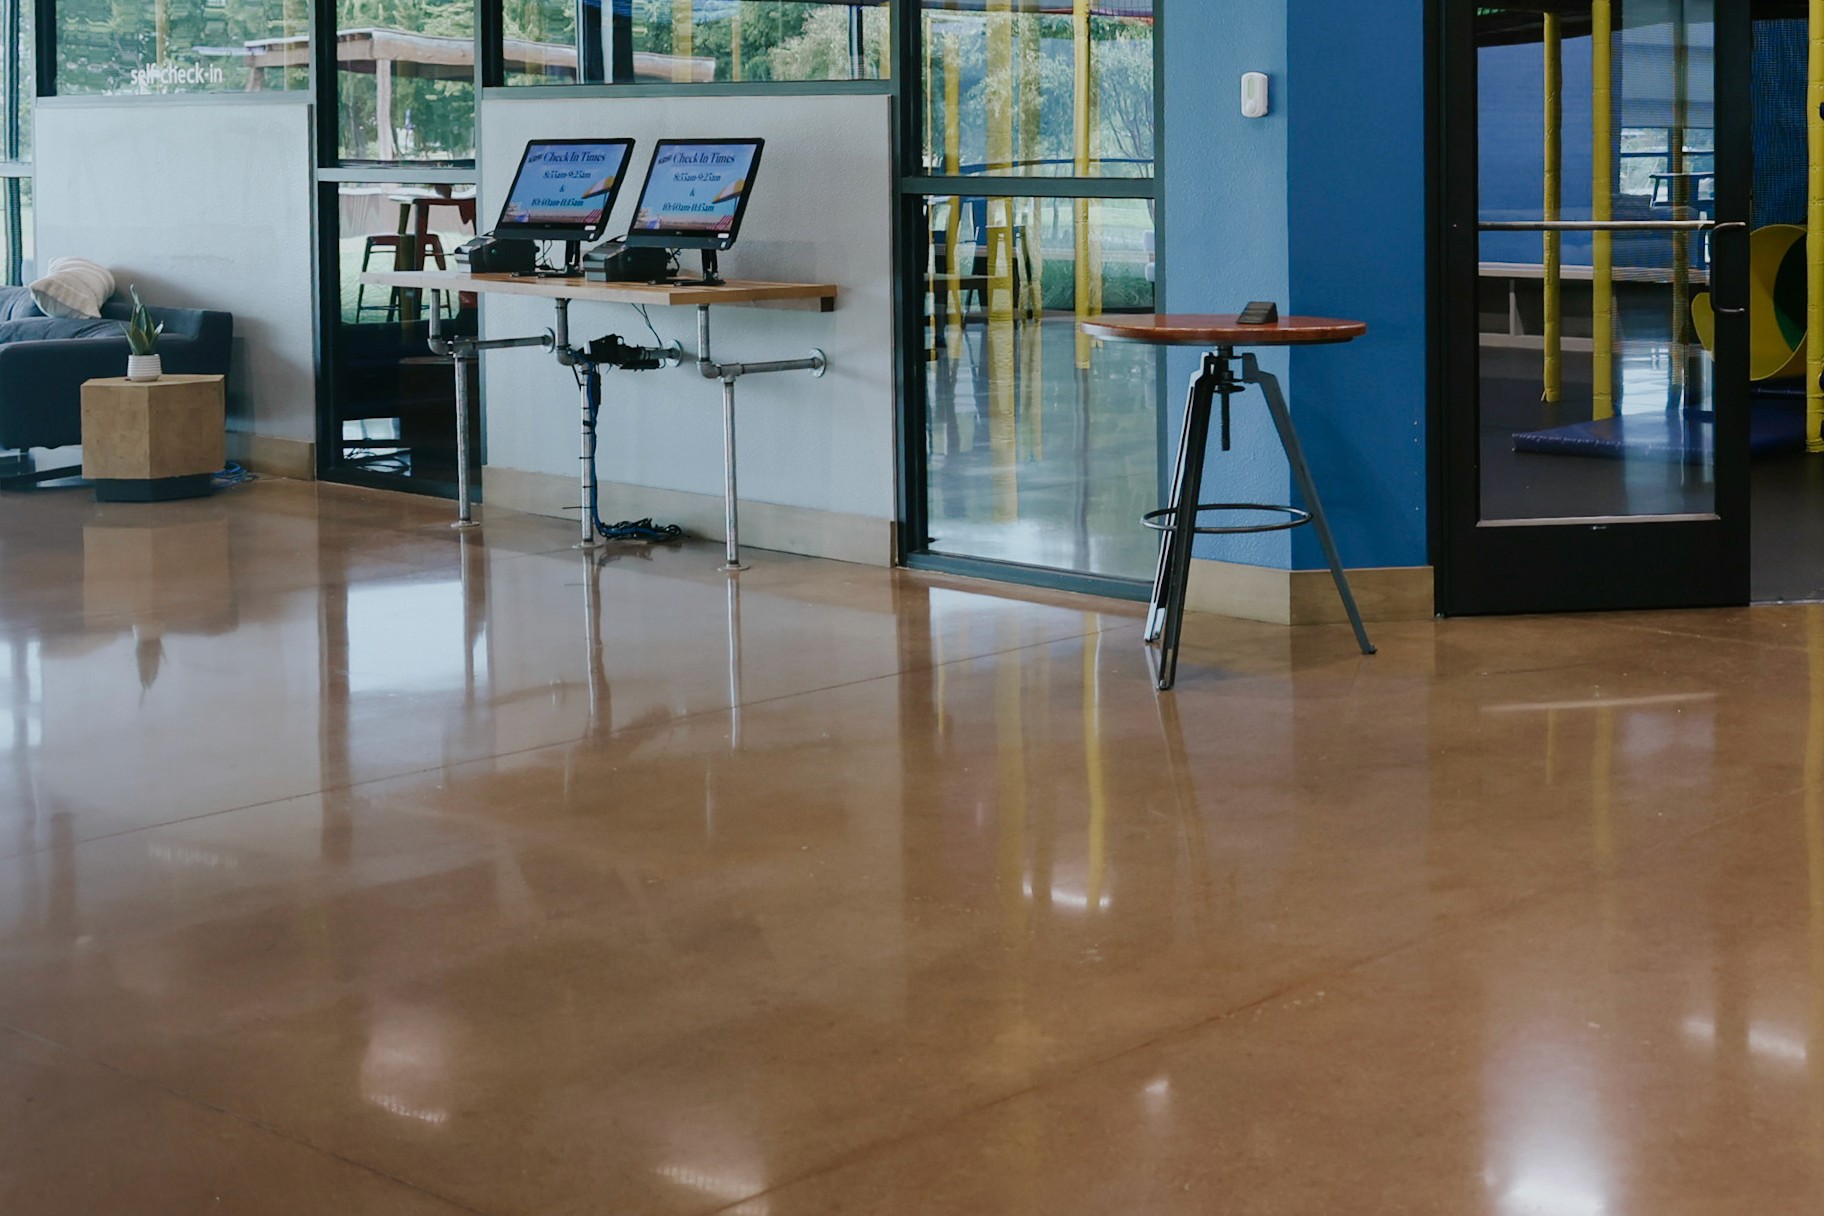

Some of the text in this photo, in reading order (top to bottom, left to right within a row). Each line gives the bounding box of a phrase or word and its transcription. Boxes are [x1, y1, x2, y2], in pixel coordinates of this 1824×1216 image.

[543, 151, 568, 163] Check
[569, 151, 580, 163] In
[581, 151, 607, 163] Times
[673, 152, 698, 164] Check
[699, 152, 709, 164] In
[711, 152, 736, 164] Times
